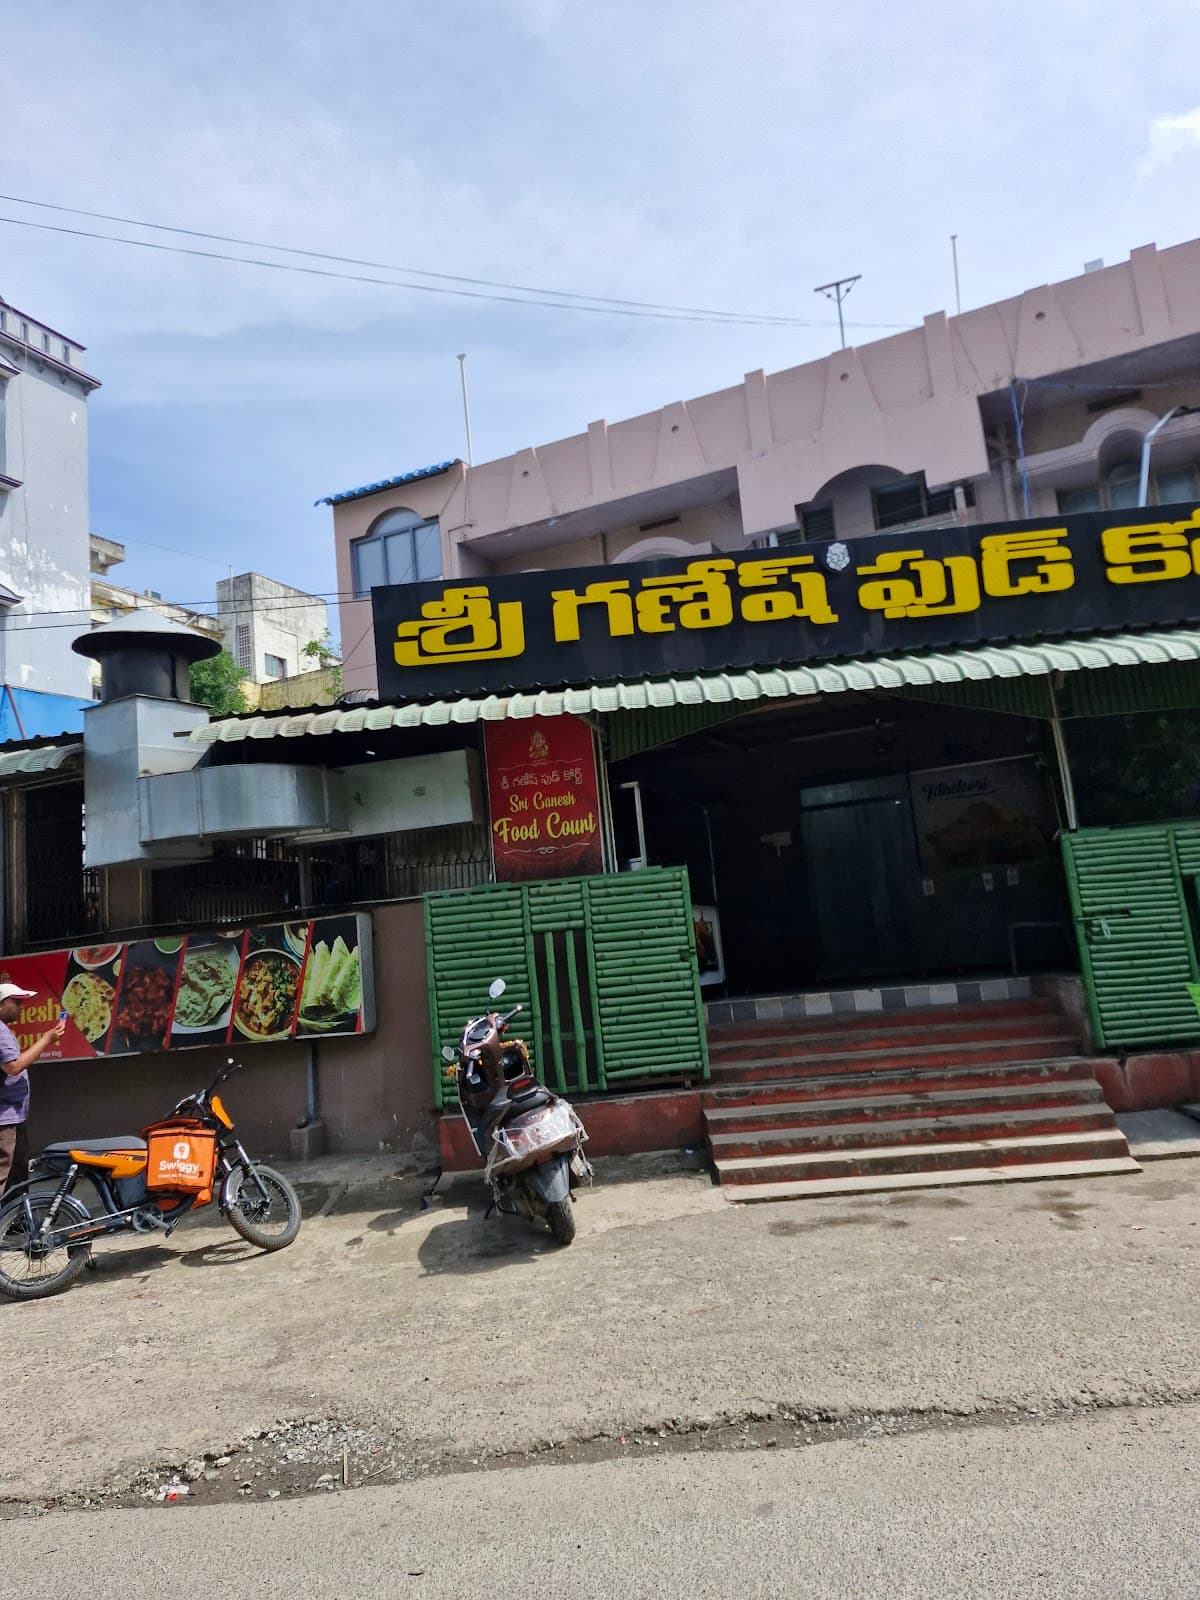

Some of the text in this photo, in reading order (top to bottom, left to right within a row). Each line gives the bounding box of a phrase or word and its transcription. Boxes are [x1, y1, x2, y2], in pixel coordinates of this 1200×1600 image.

[394, 587, 525, 667] శ్రీ
[510, 791, 577, 813] Sri Ganesh
[493, 812, 597, 845] Food Court
[159, 1160, 199, 1174] Swiggy
